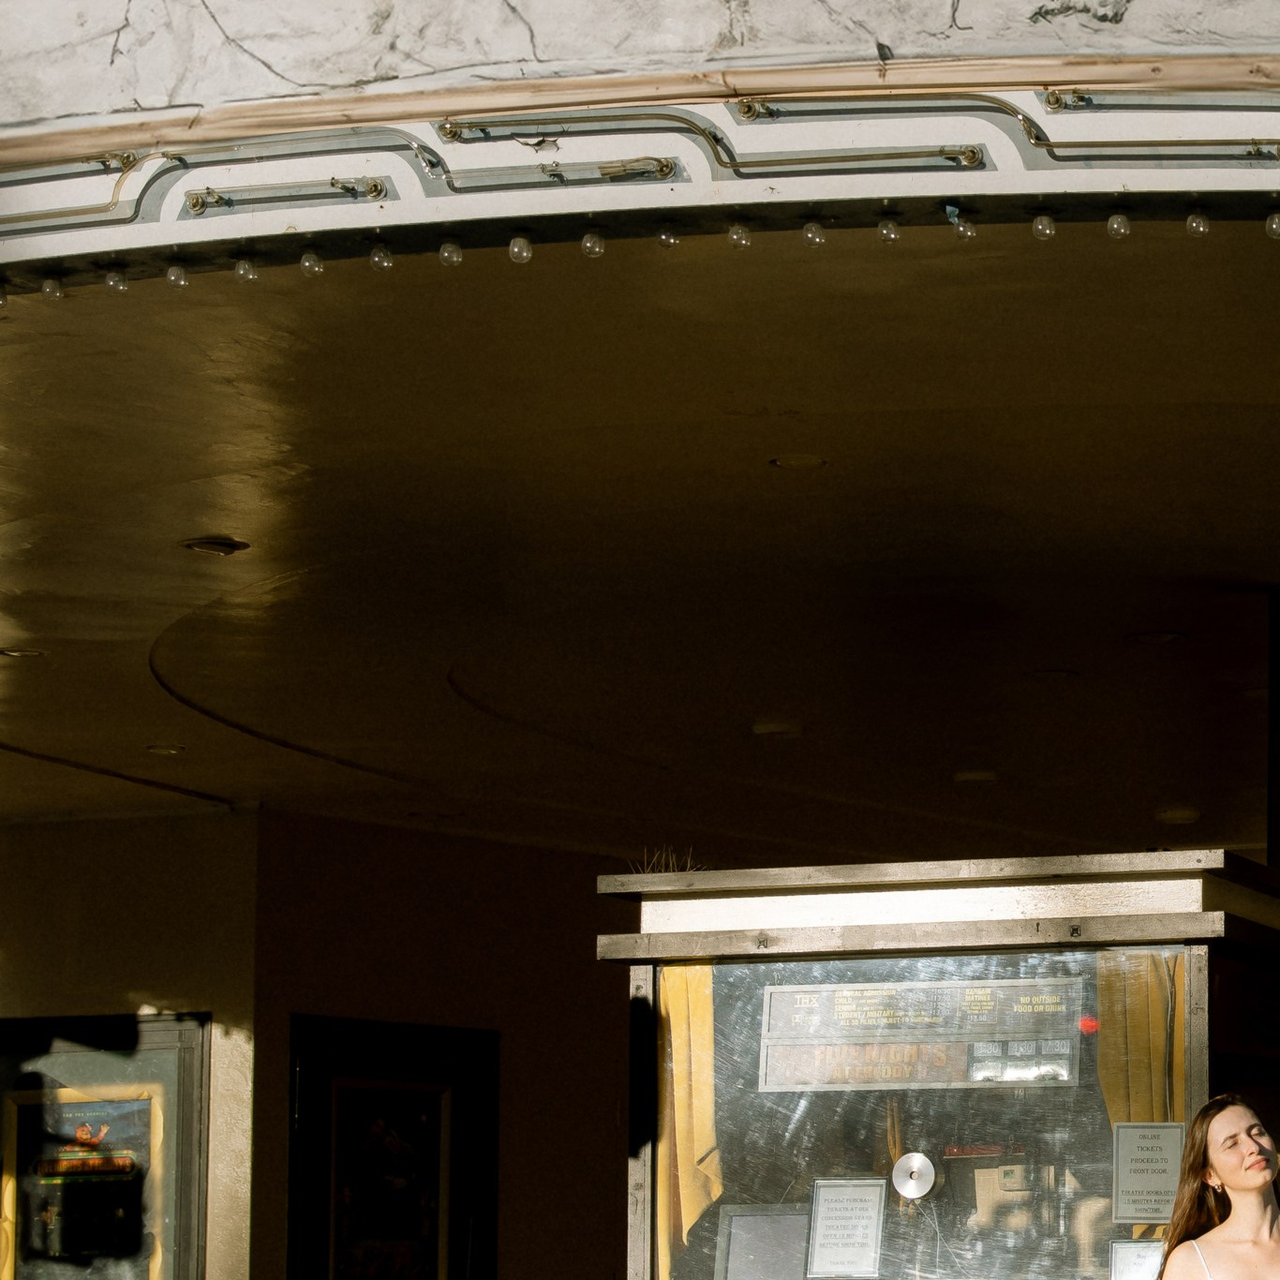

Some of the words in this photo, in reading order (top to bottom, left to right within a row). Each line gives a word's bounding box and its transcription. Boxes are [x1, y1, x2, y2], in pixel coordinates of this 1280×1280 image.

[795, 994, 820, 1008] THX
[835, 997, 852, 1005] CHILD
[965, 994, 991, 1002] MATINEE
[1020, 996, 1031, 1004] NO
[1031, 995, 1061, 1003] OUTSIDE
[1014, 1005, 1033, 1013] FOOD
[1033, 1004, 1045, 1012] OR
[1045, 1004, 1067, 1012] DRINK
[834, 1011, 860, 1020] STUDENT
[867, 1010, 897, 1019] MILITARY
[815, 1044, 860, 1068] FIVE
[865, 1043, 947, 1067] NIGHTS
[1045, 1040, 1067, 1053] 7:30
[832, 1066, 852, 1079] AT
